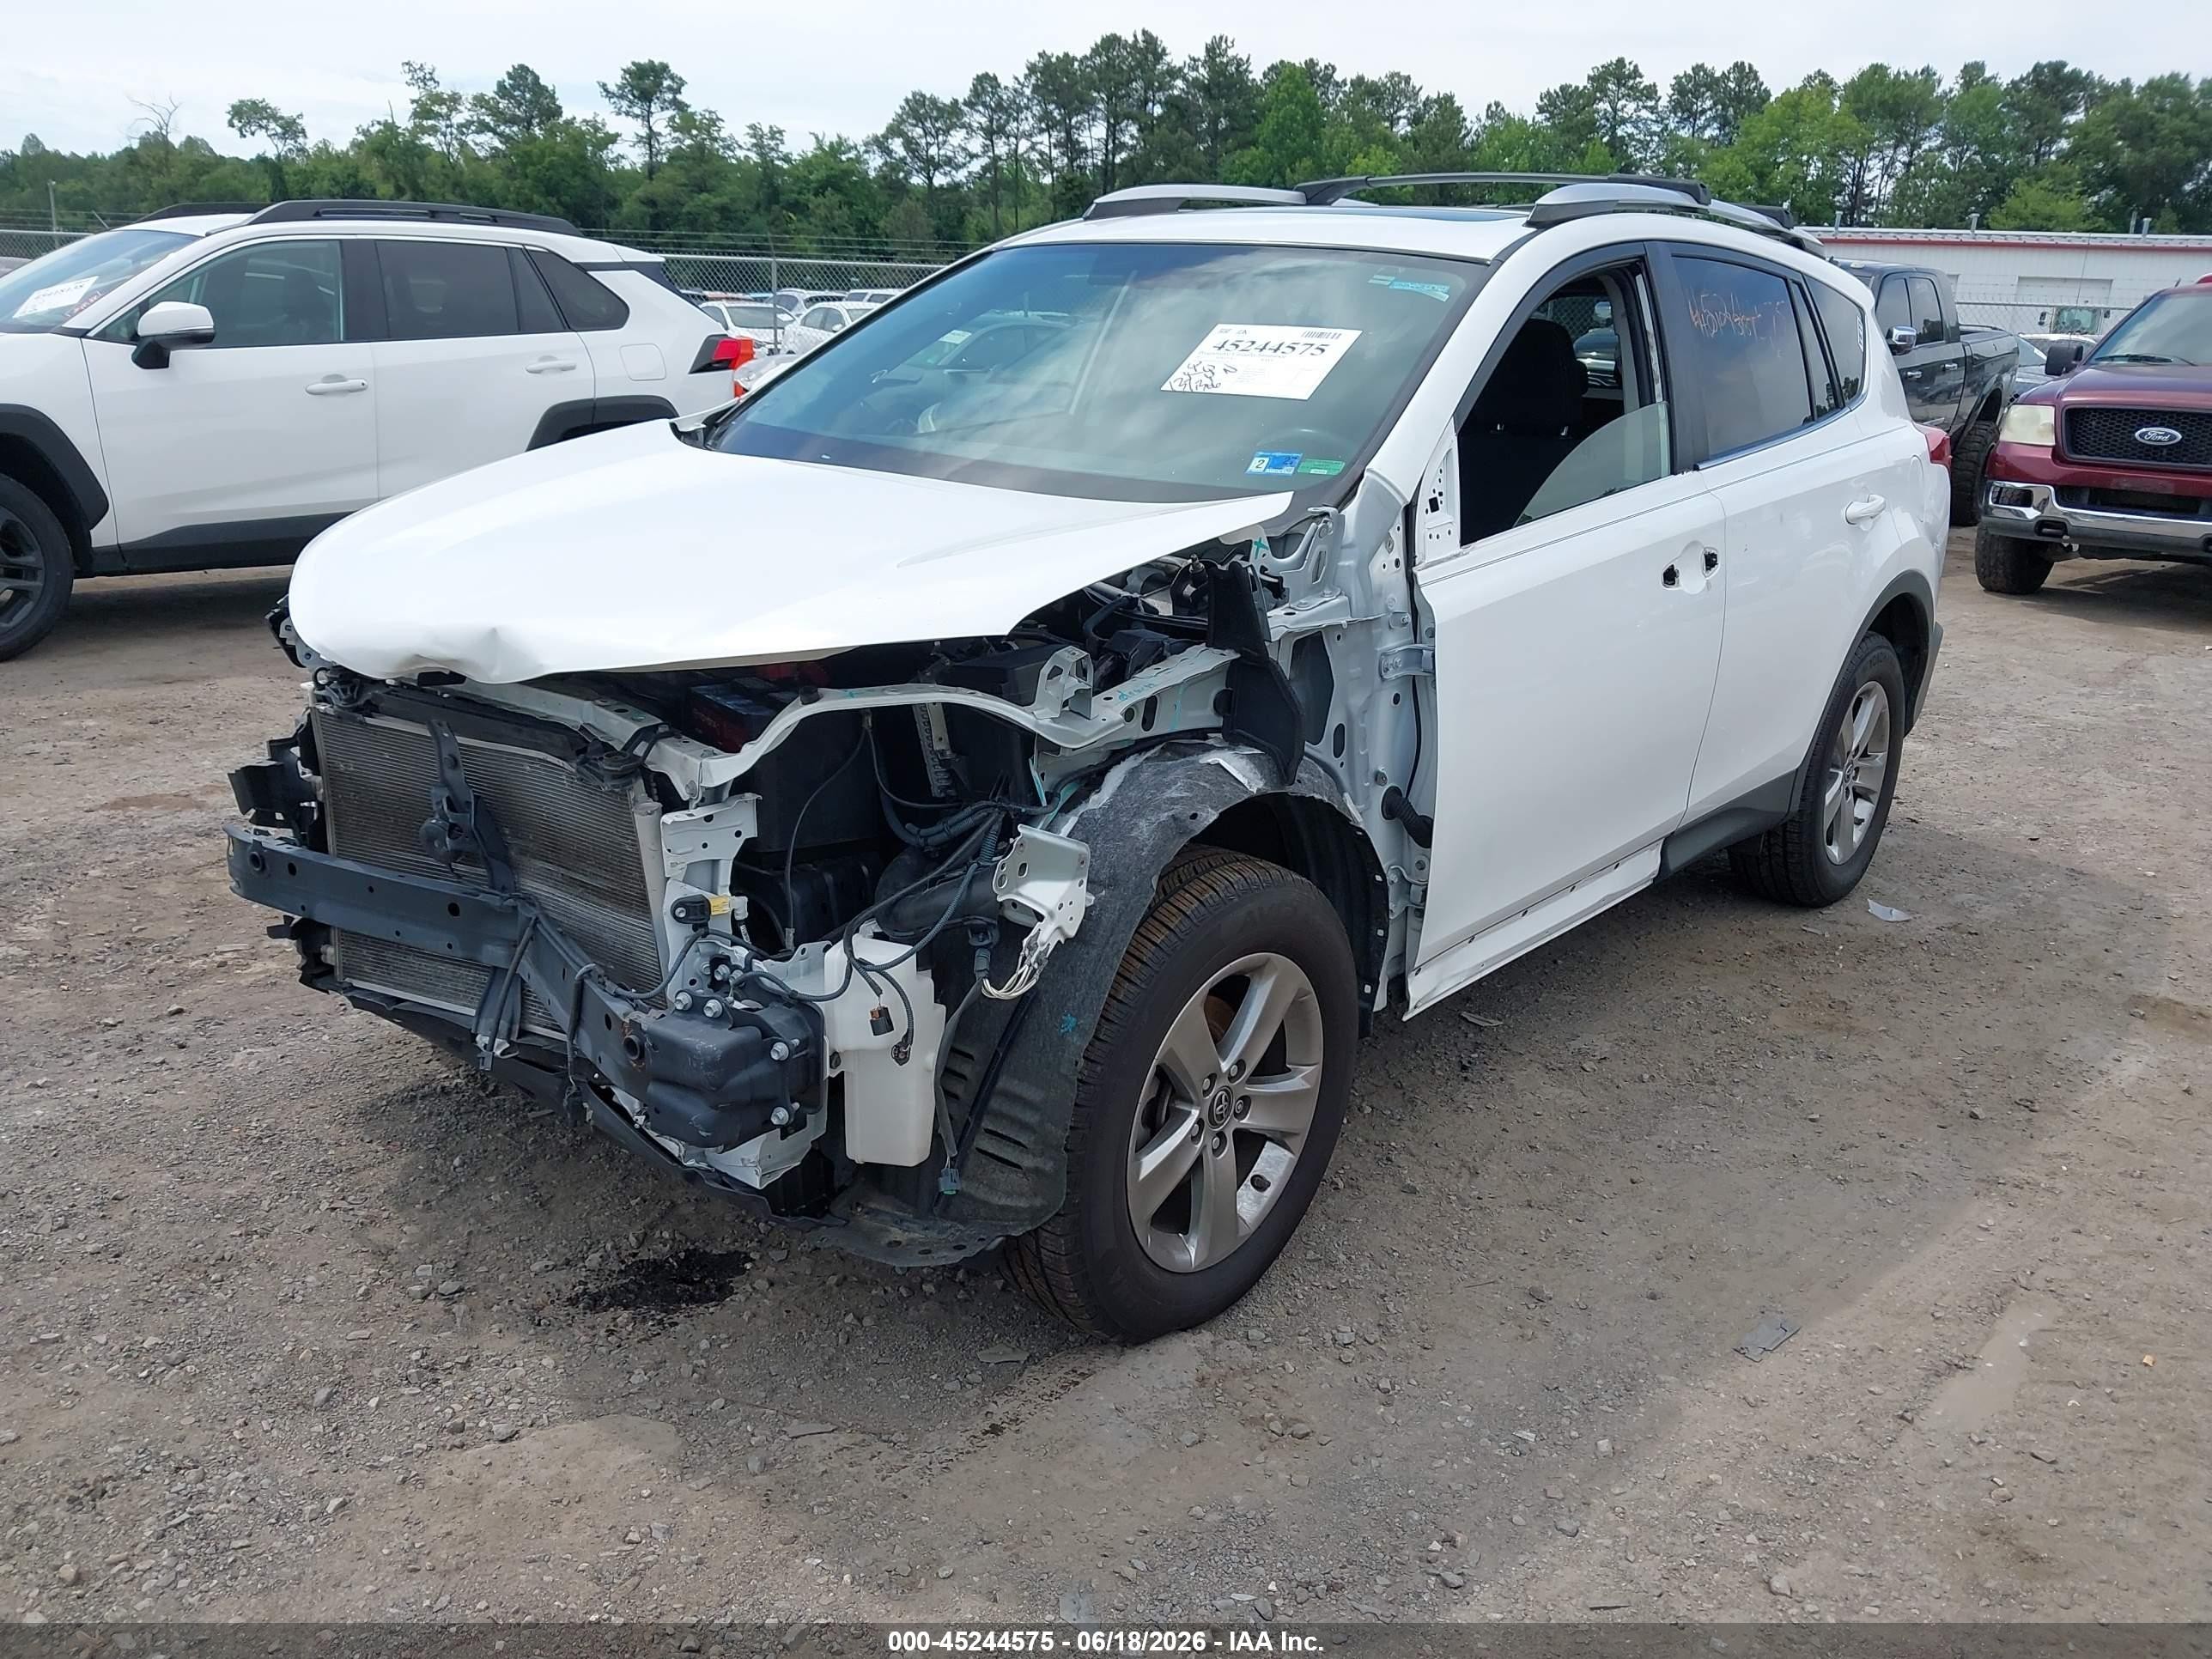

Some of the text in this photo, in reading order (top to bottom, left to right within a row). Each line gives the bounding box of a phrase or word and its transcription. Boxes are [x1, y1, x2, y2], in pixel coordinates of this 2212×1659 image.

[1212, 339, 1330, 356] 45244575
[2143, 430, 2172, 441] Ford
[1255, 459, 1266, 470] 2
